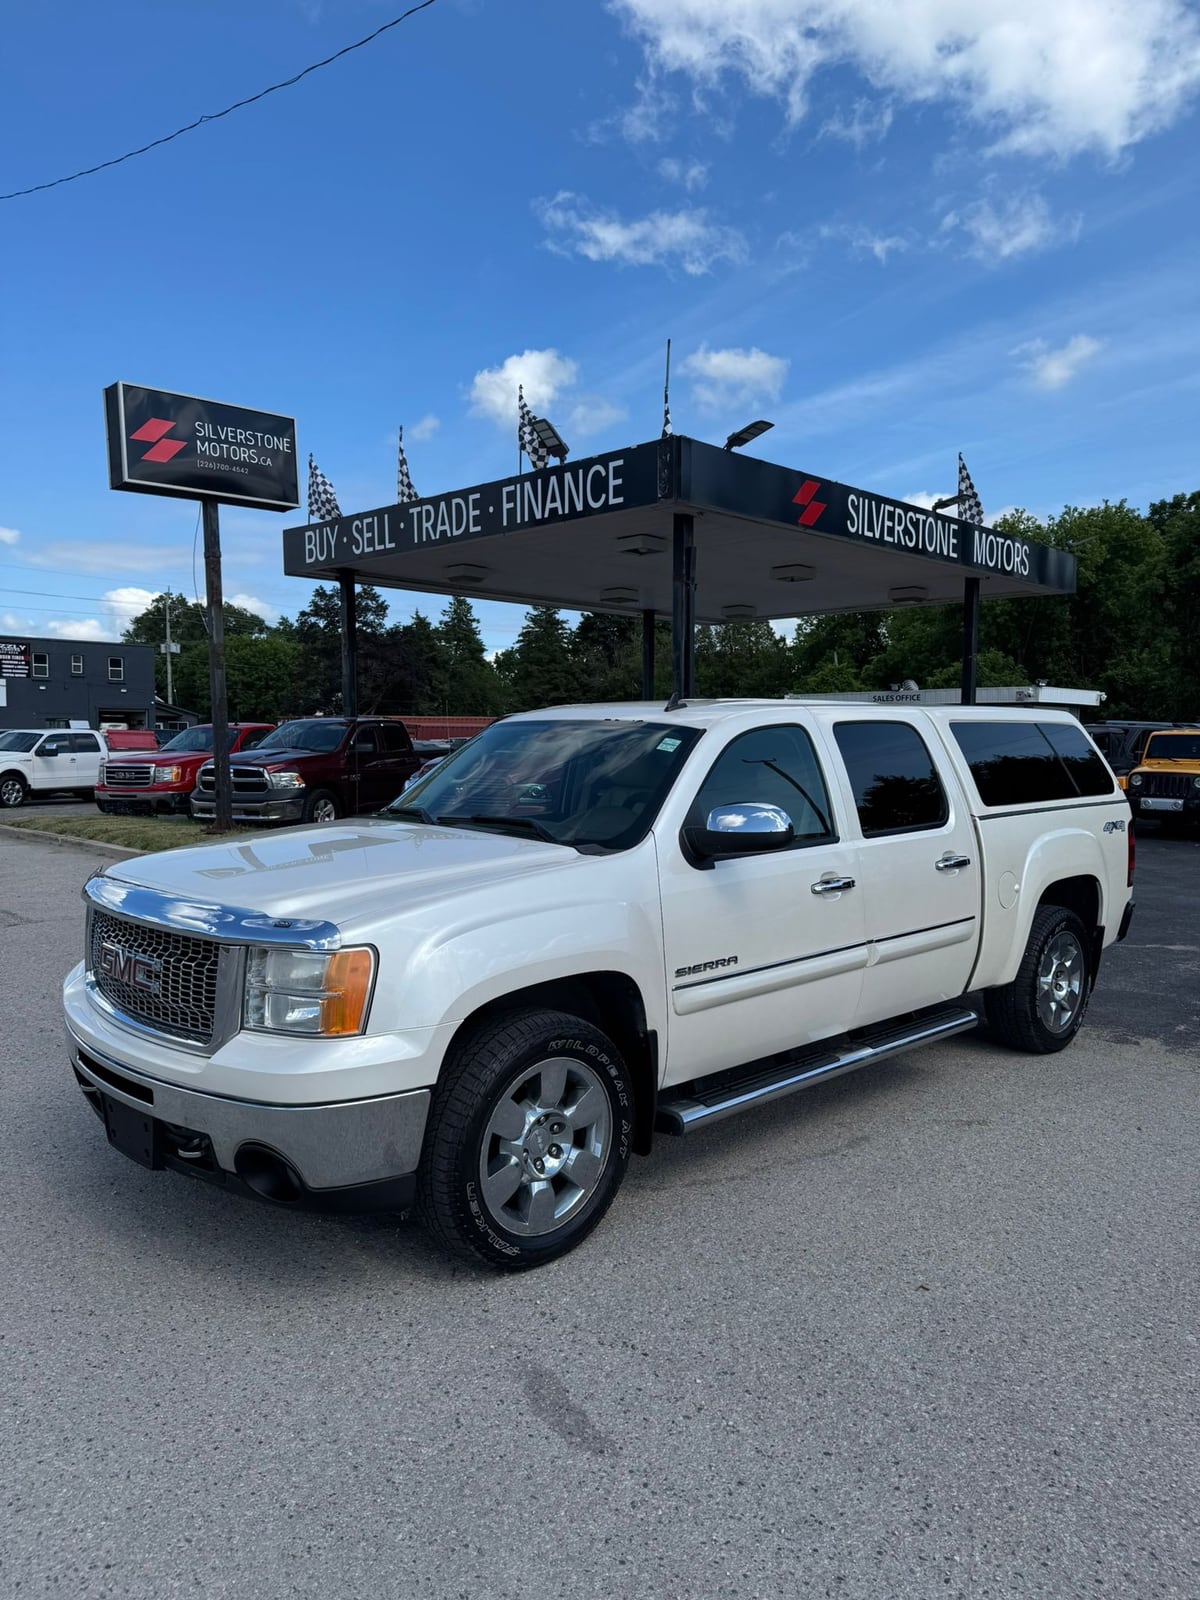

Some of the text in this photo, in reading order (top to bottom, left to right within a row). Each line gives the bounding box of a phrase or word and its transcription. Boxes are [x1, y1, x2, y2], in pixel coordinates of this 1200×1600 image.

[194, 421, 291, 453] SILVERSTONE
[196, 439, 273, 467] MOTORS.CA
[304, 459, 624, 563] BUY SELL TRADE FINANCE
[847, 494, 1029, 576] SILVERSTONE MOTORS
[895, 694, 921, 702] OFFICE
[100, 942, 161, 995] GMC
[674, 955, 738, 978] SIERRA
[547, 1038, 632, 1160] WILDPEAK A/T
[466, 1181, 521, 1257] FALKEN
